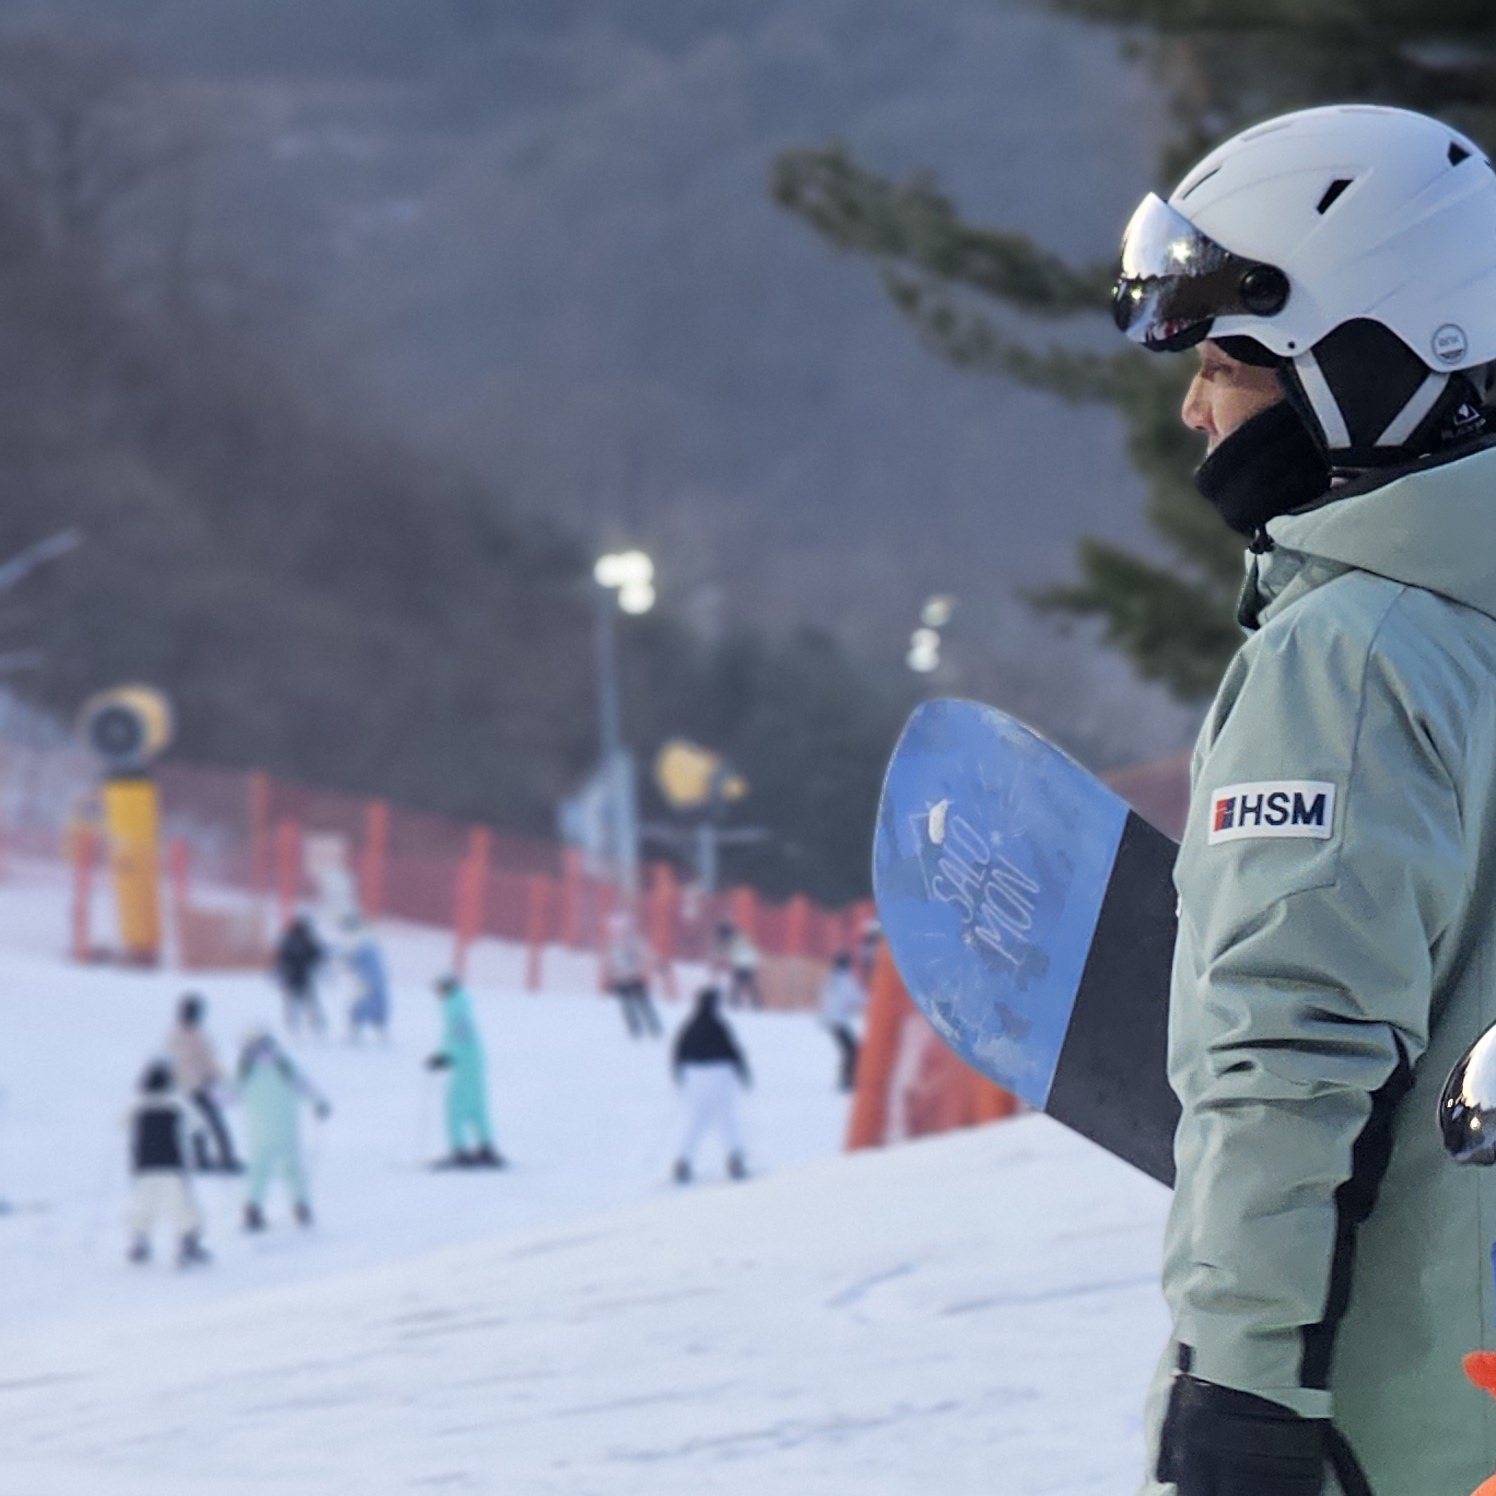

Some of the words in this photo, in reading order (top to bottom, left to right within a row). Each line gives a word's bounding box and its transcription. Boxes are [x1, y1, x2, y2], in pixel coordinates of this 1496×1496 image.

[1238, 792, 1326, 826] HSM
[932, 815, 990, 923] SALO
[976, 856, 1040, 966] MON
